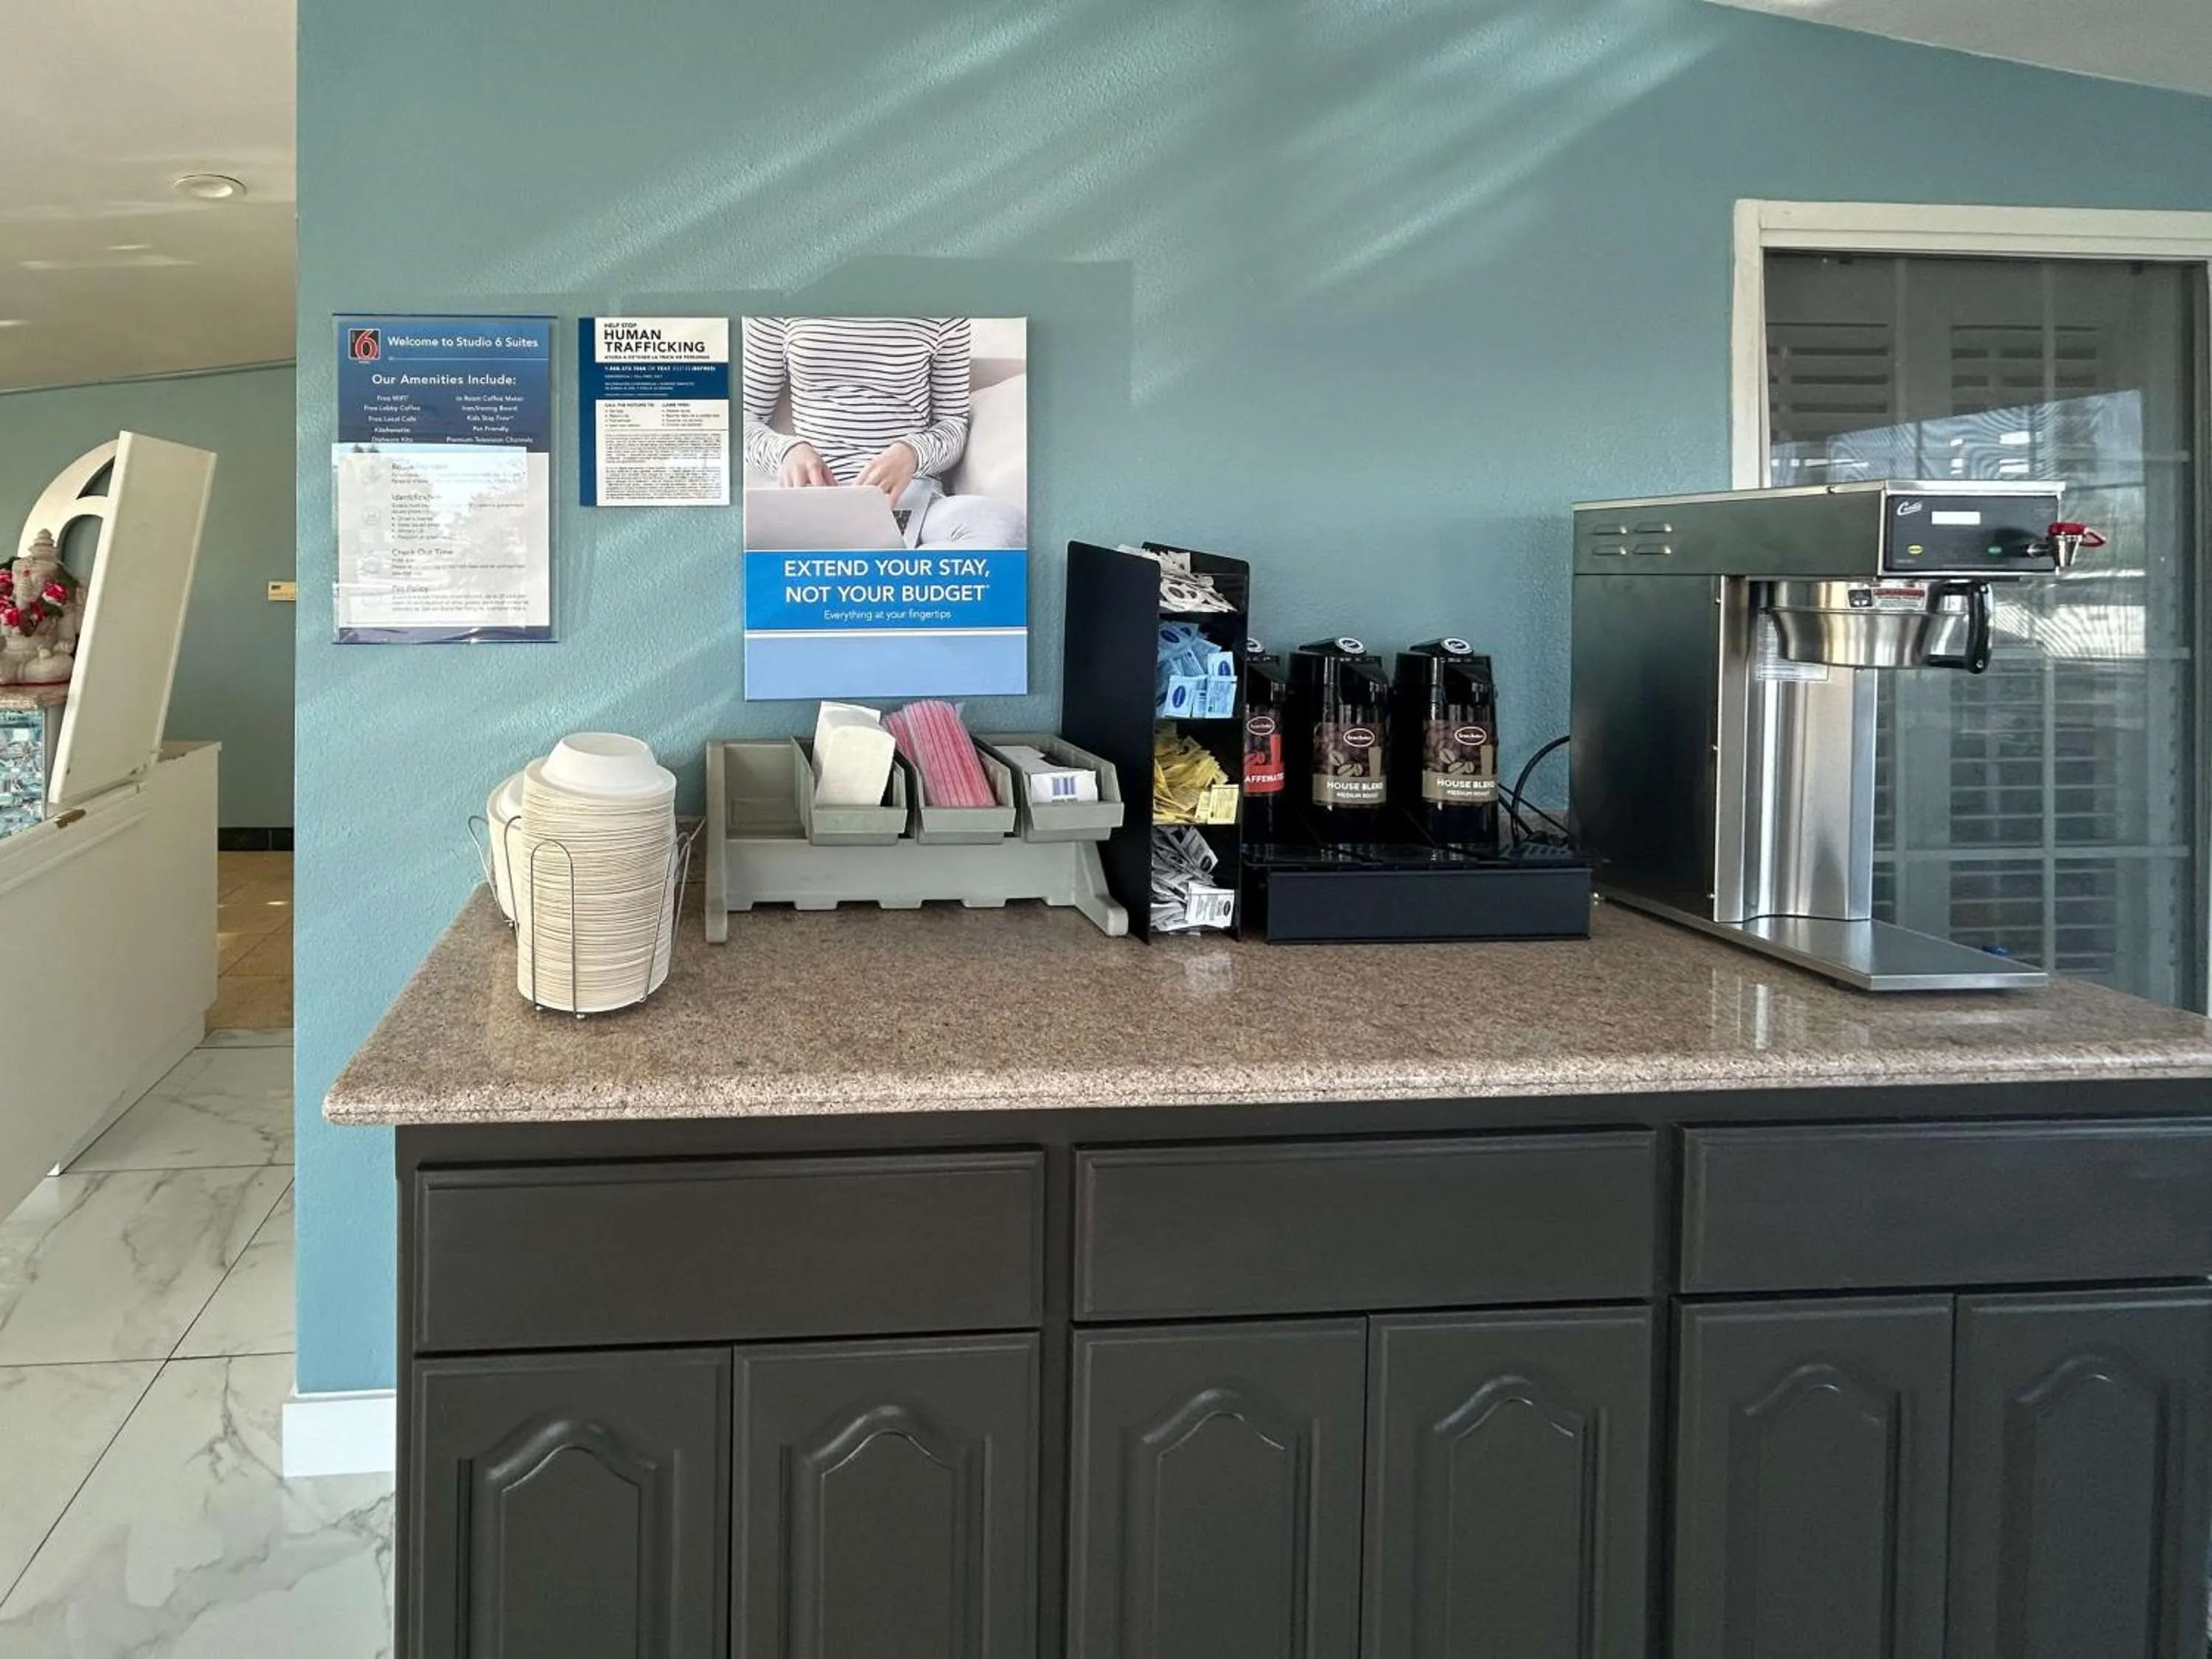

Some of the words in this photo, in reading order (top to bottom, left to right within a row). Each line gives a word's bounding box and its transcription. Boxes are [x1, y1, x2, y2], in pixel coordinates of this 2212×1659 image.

[604, 330, 661, 340] HUMAN
[388, 336, 439, 347] Welcome
[442, 337, 453, 347] to
[456, 336, 491, 347] Studio
[495, 338, 501, 347] 6
[505, 336, 538, 347] Suites
[604, 341, 706, 352] TRAFFICKING
[372, 375, 394, 385] Our
[400, 375, 464, 385] Amenities
[468, 375, 516, 385] Include:
[785, 560, 869, 577] EXTEND
[875, 560, 932, 577] YOUR
[939, 559, 990, 577] STAY,
[785, 587, 831, 602] NOT
[838, 586, 894, 602] YOUR
[824, 610, 872, 622] Everything
[875, 611, 884, 619] at
[886, 611, 906, 622] your
[908, 608, 951, 622] fingertips
[1326, 780, 1360, 790] HOUSE
[1362, 782, 1383, 790] BLEND
[1437, 779, 1471, 788] HOUSE
[1472, 780, 1495, 788] BLEND
